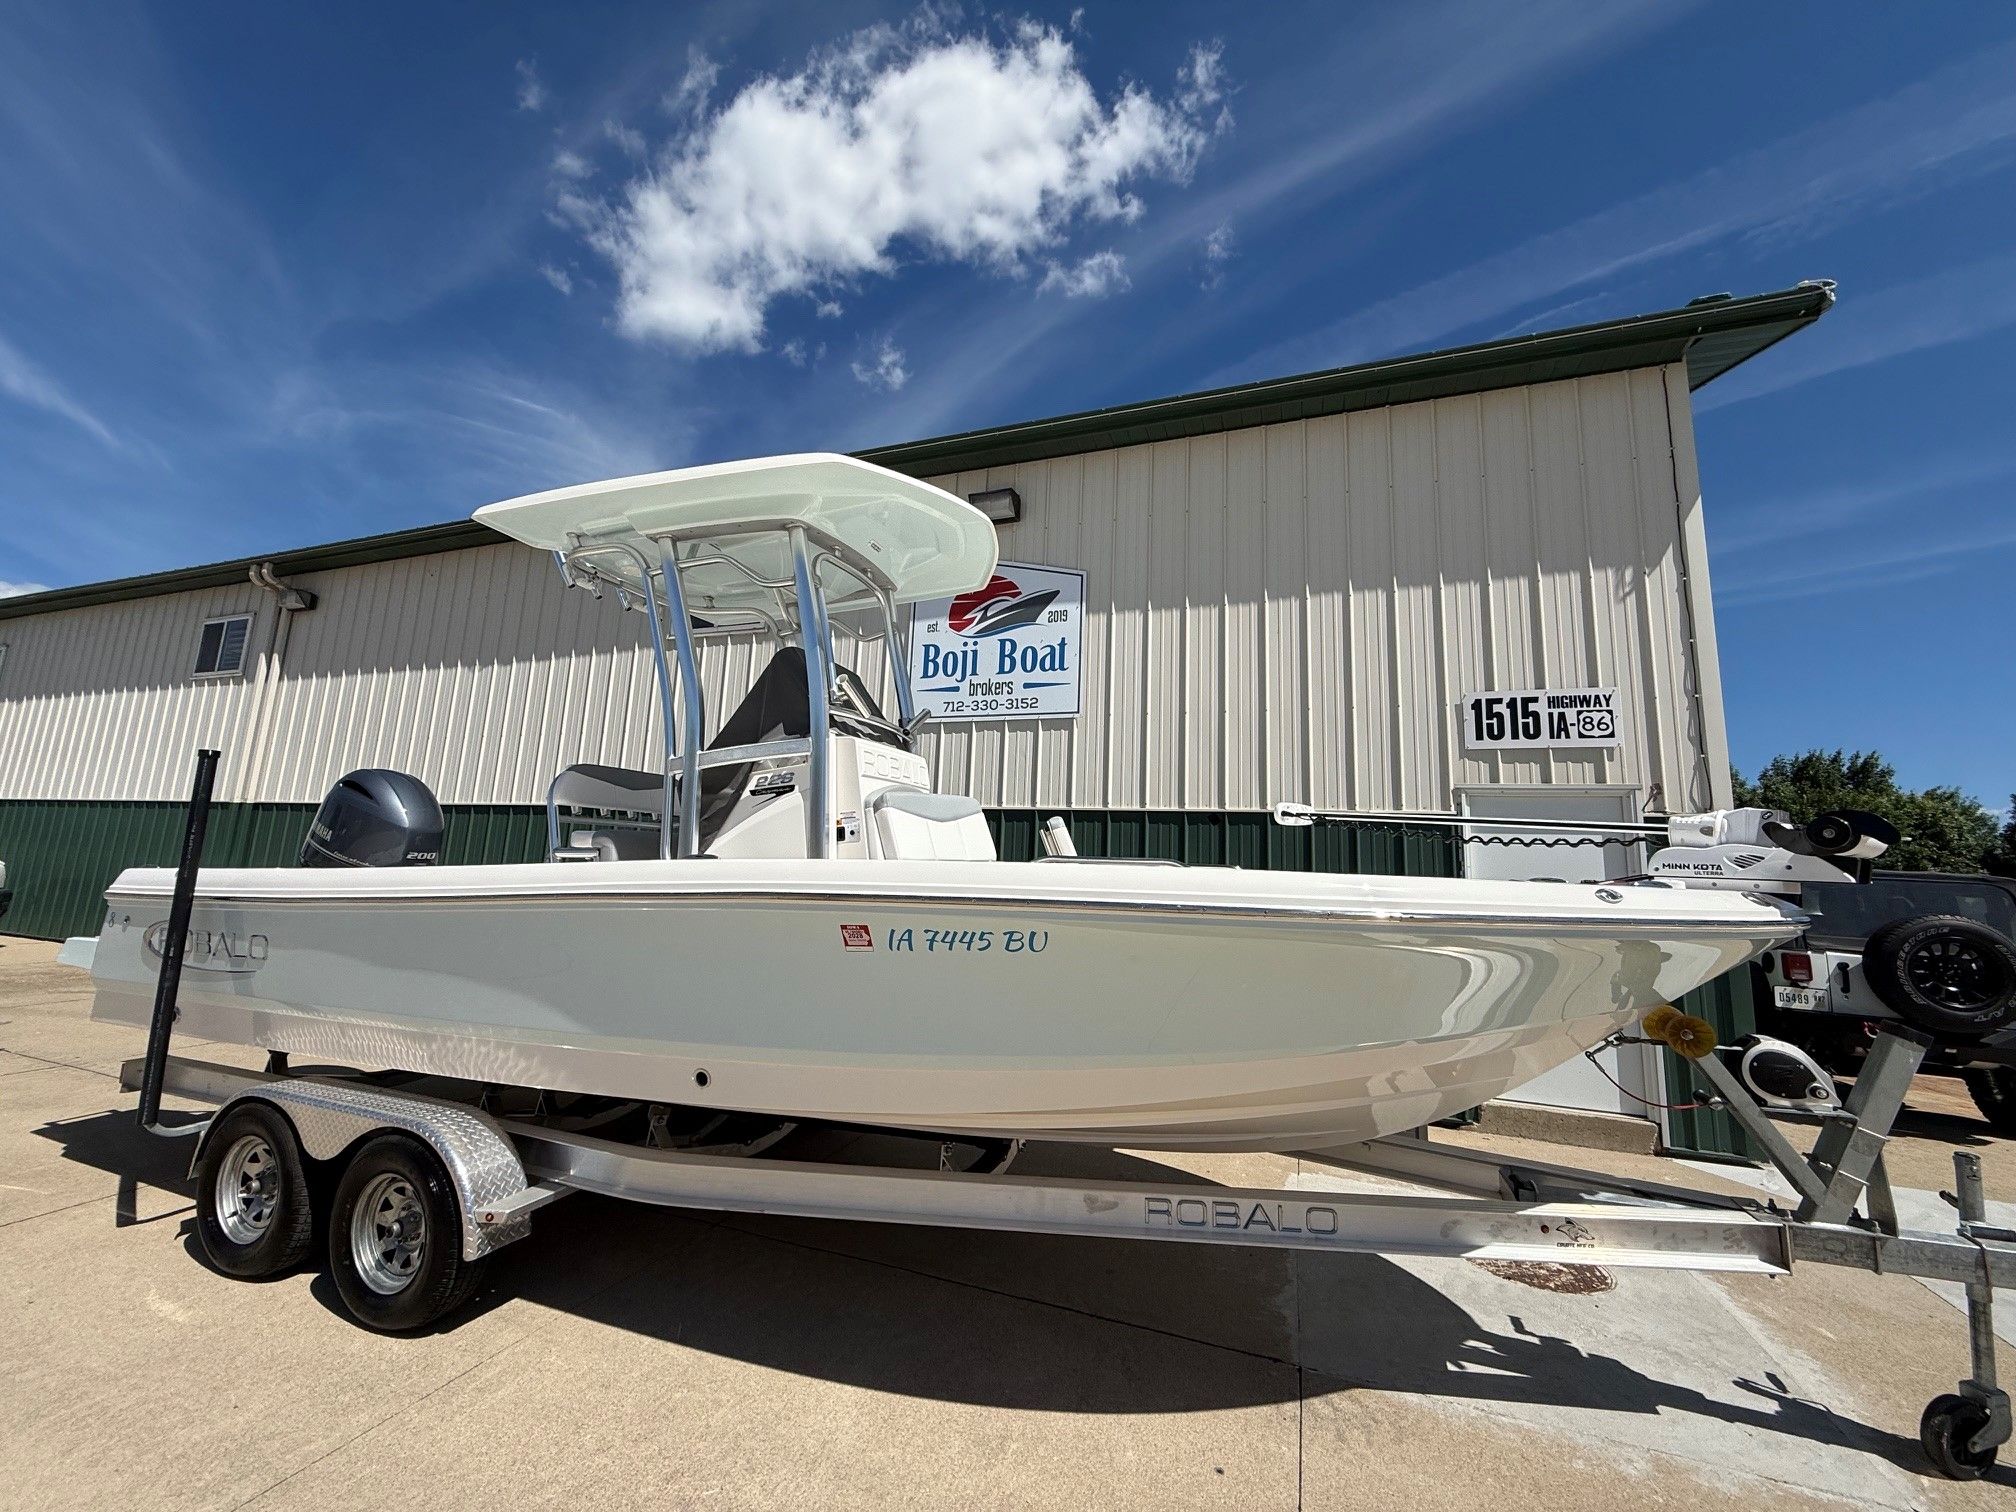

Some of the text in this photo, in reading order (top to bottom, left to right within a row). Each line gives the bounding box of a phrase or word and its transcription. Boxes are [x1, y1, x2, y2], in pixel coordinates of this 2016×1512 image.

[927, 609, 1068, 634] est. 2019
[920, 637, 1069, 683] Boji Boat
[968, 679, 1014, 697] brokers
[943, 698, 1039, 713] 712-330-3152
[1547, 694, 1613, 709] HIGHWAY
[1470, 696, 1542, 741] 1515
[406, 851, 437, 860] 200
[1662, 862, 1723, 871] MINN KOTA
[888, 929, 1049, 953] IA 7445 BU
[1145, 1197, 1338, 1235] ROBALO
